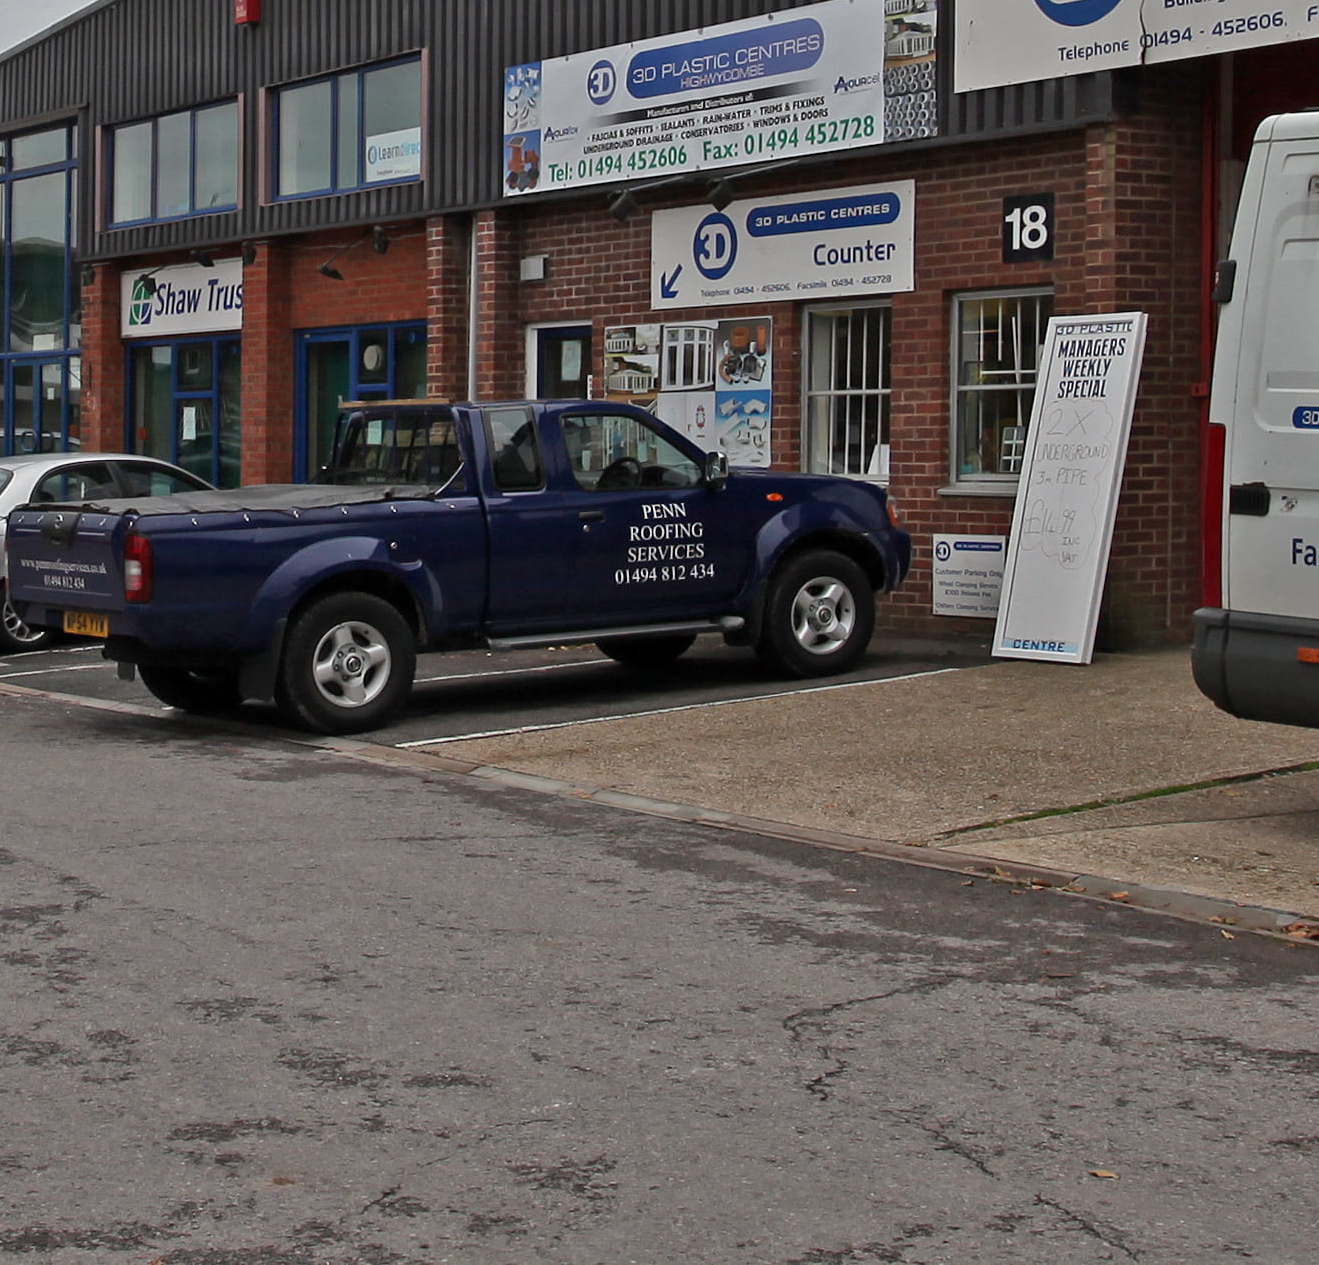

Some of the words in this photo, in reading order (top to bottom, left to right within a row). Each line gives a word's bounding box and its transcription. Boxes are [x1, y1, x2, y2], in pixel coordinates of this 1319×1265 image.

[1058, 39, 1130, 62] Telephone
[1140, 26, 1193, 49] 01494
[633, 67, 656, 84] 3D
[662, 52, 730, 79] PLASTIC
[735, 34, 820, 66] CENTRES
[589, 67, 613, 98] 3D
[626, 125, 653, 136] SOFFITS
[661, 118, 695, 131] SEALANTS
[703, 109, 752, 124] RAIN-WATER
[760, 105, 783, 115] TRIMS
[793, 96, 825, 110] FIXINGS
[584, 139, 634, 154] UNDERGROUND
[636, 133, 674, 147] DRAINAGE
[681, 122, 745, 140] CONSERVATORIES
[753, 115, 791, 128] WINDOWS
[801, 108, 829, 120] DOORS
[548, 164, 573, 182] Tel:
[577, 155, 623, 178] 01494
[628, 145, 687, 171] 452606
[703, 140, 738, 162] Fax:
[744, 127, 799, 155] 01494
[805, 115, 874, 145] 452728
[755, 216, 772, 228] 3D
[776, 210, 826, 225] PLASTIC
[831, 203, 890, 219] CENTRES
[1005, 204, 1048, 250] 18
[699, 222, 731, 270] 3D
[813, 240, 896, 266] Counter
[862, 275, 892, 285] 452728
[155, 282, 202, 316] Shaw
[1058, 337, 1126, 358] MANAGERS
[1063, 358, 1112, 378] WEEKLY
[1058, 379, 1106, 399] SPECIAL
[1036, 443, 1109, 463] UNDERGROUND
[1056, 467, 1088, 485] PIPE
[641, 502, 687, 520] PENN
[629, 522, 704, 542] ROOFING
[627, 543, 705, 563] SERVICES
[615, 567, 658, 584] 01494
[661, 565, 686, 581] 812
[689, 563, 715, 579] 434
[1013, 638, 1066, 653] CENTRE
